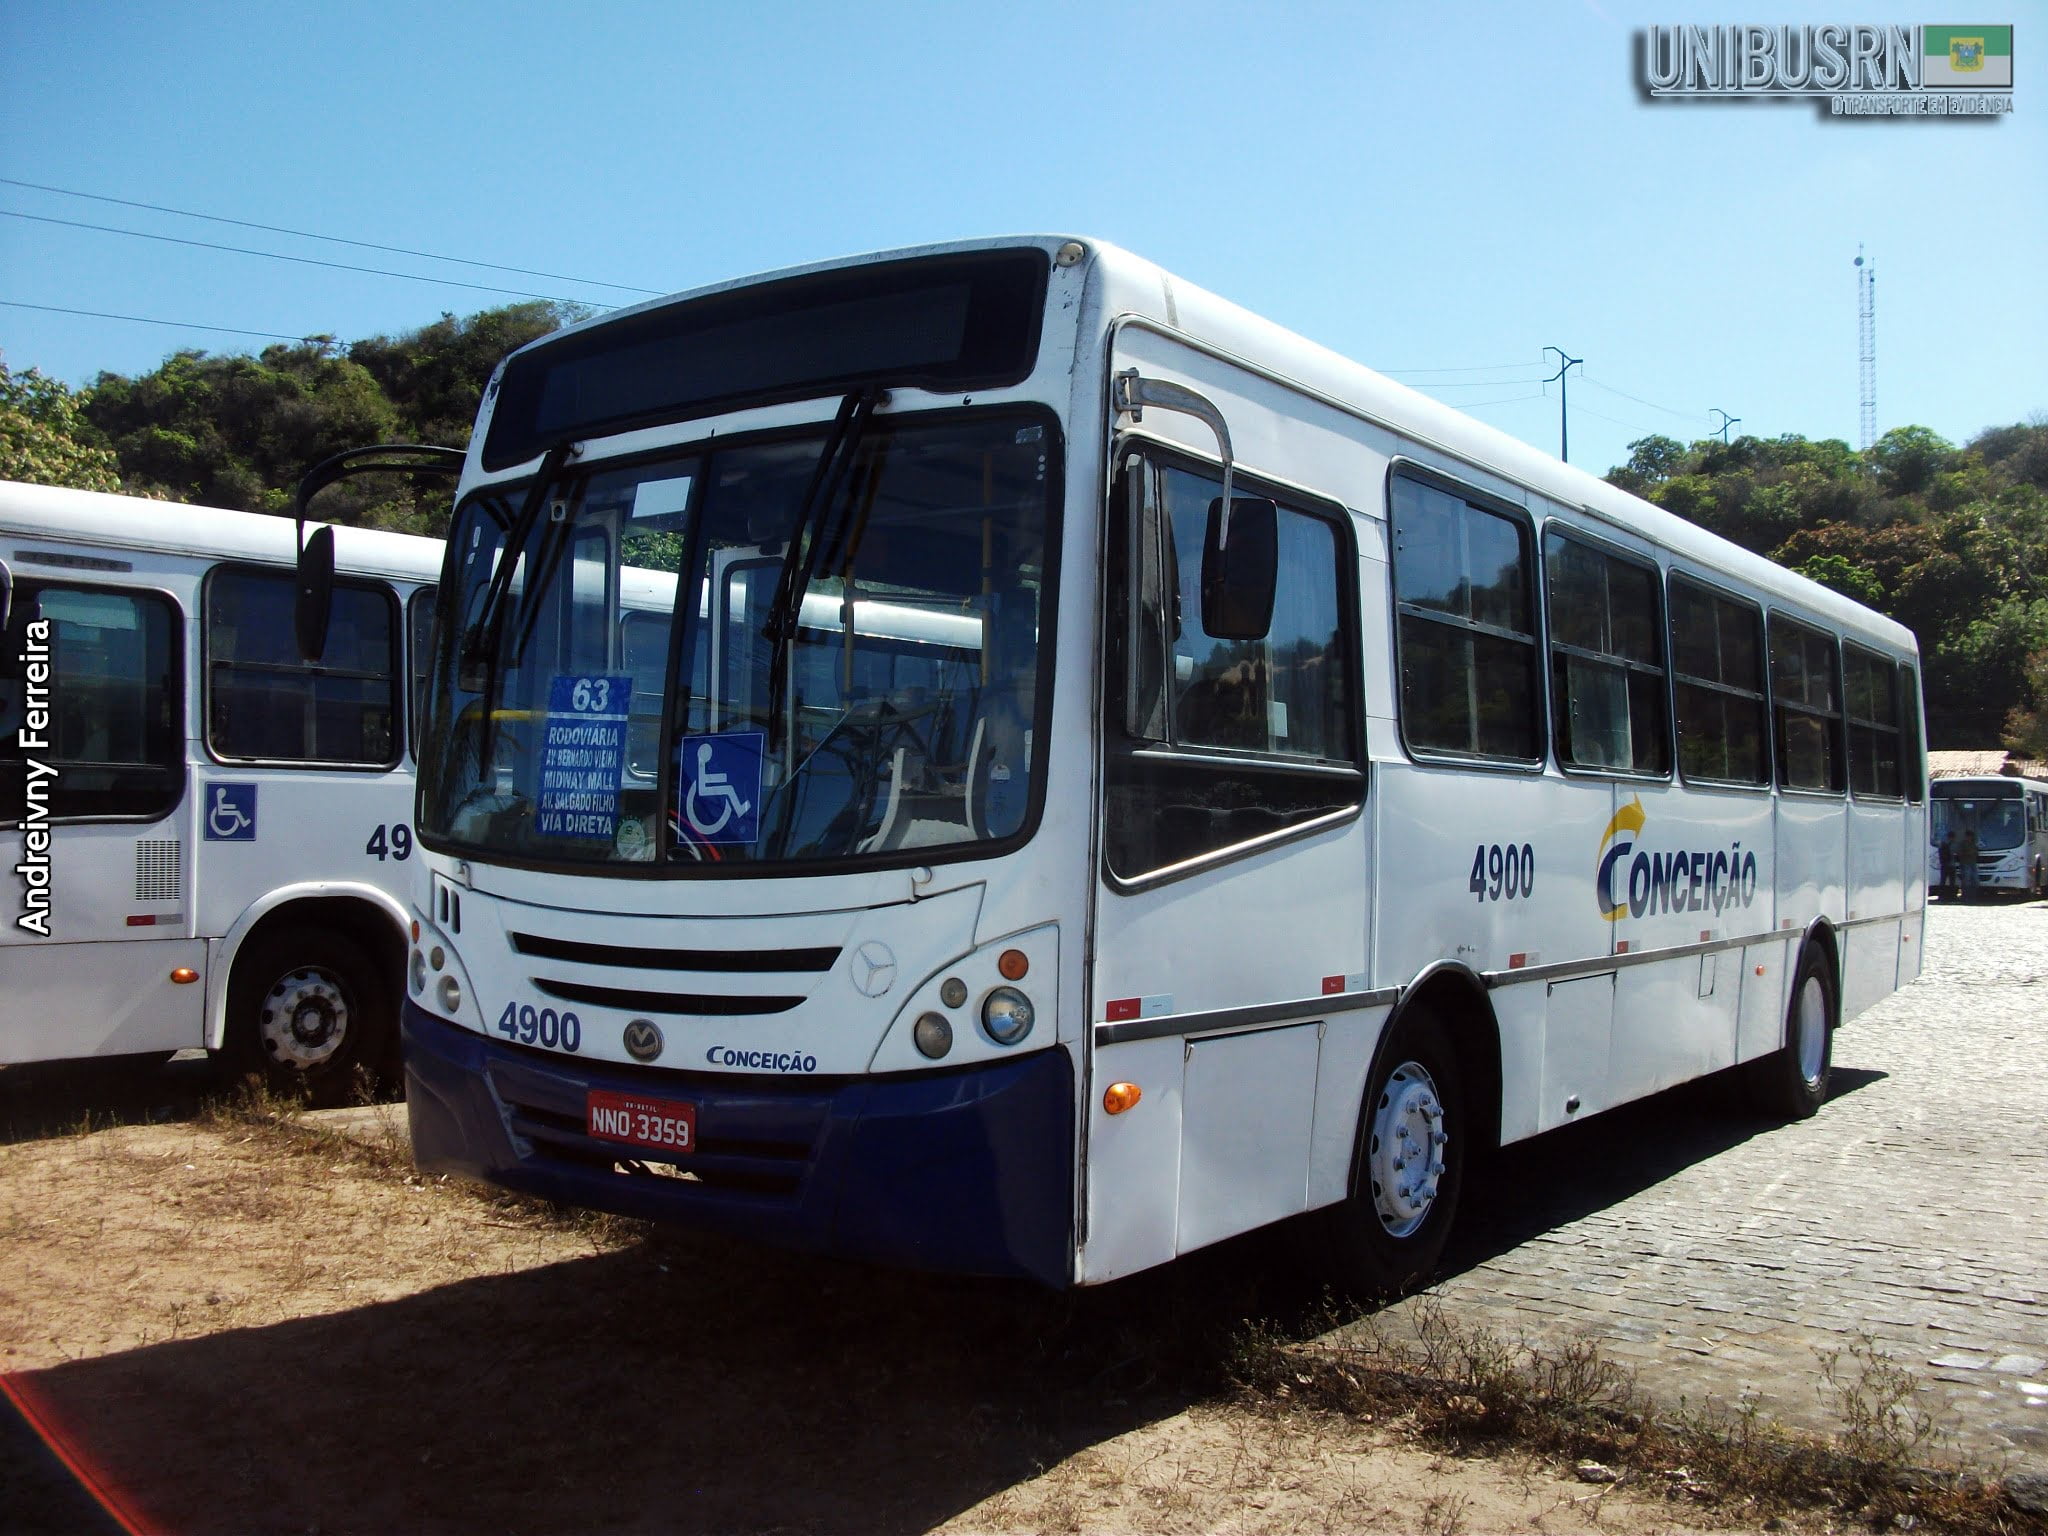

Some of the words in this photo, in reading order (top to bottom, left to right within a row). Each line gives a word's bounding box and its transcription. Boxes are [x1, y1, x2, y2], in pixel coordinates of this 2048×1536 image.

[572, 678, 610, 712] 63
[548, 723, 618, 746] RODOVIÁRIA
[557, 749, 593, 768] BERNARDO
[595, 750, 617, 768] VIEIRA
[544, 771, 585, 790] MIDWAY
[587, 772, 615, 791] MALL
[554, 793, 592, 811] SALGADO
[592, 794, 615, 812] FILHO
[541, 814, 562, 832] VIA
[565, 814, 613, 834] DIRETA
[1469, 843, 1534, 902] 4900
[498, 1001, 581, 1053] 4900
